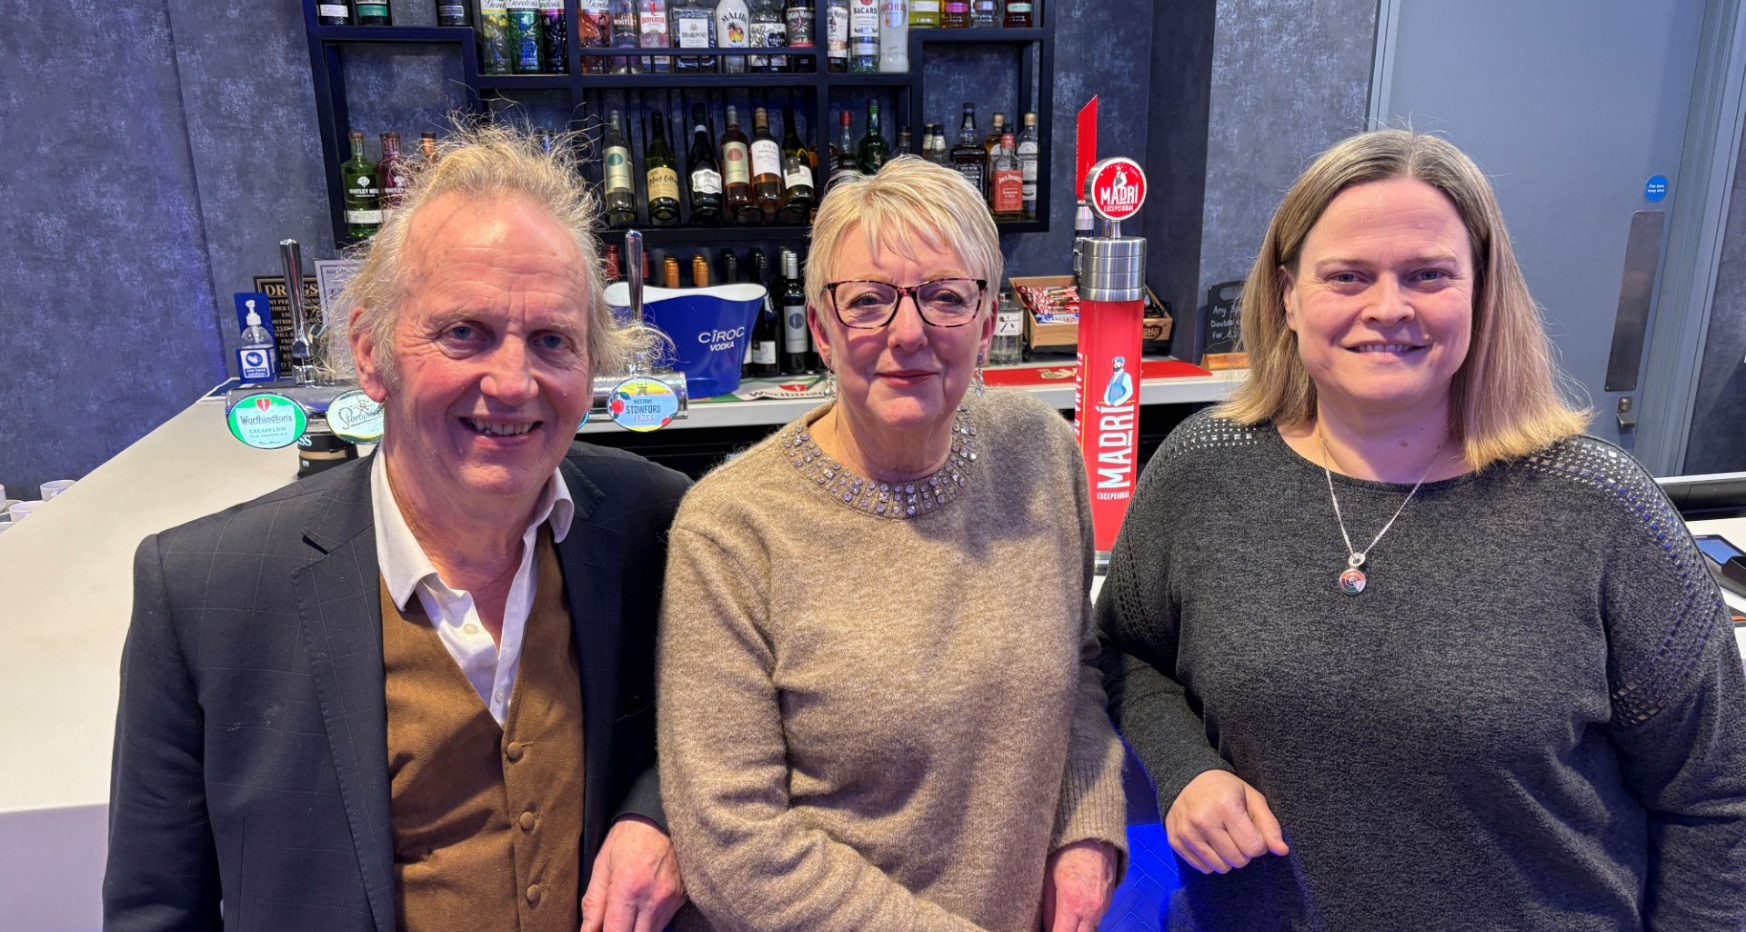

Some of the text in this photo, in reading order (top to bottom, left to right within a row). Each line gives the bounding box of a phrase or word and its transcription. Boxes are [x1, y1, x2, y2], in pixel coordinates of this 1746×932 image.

[264, 283, 320, 297] DRGS
[710, 341, 735, 352] VODKA
[626, 405, 661, 414] STOWFORD
[240, 414, 293, 426] Worthington's
[1095, 405, 1135, 489] MADRÍ
[1096, 491, 1130, 501] EXCEPCIONAL
